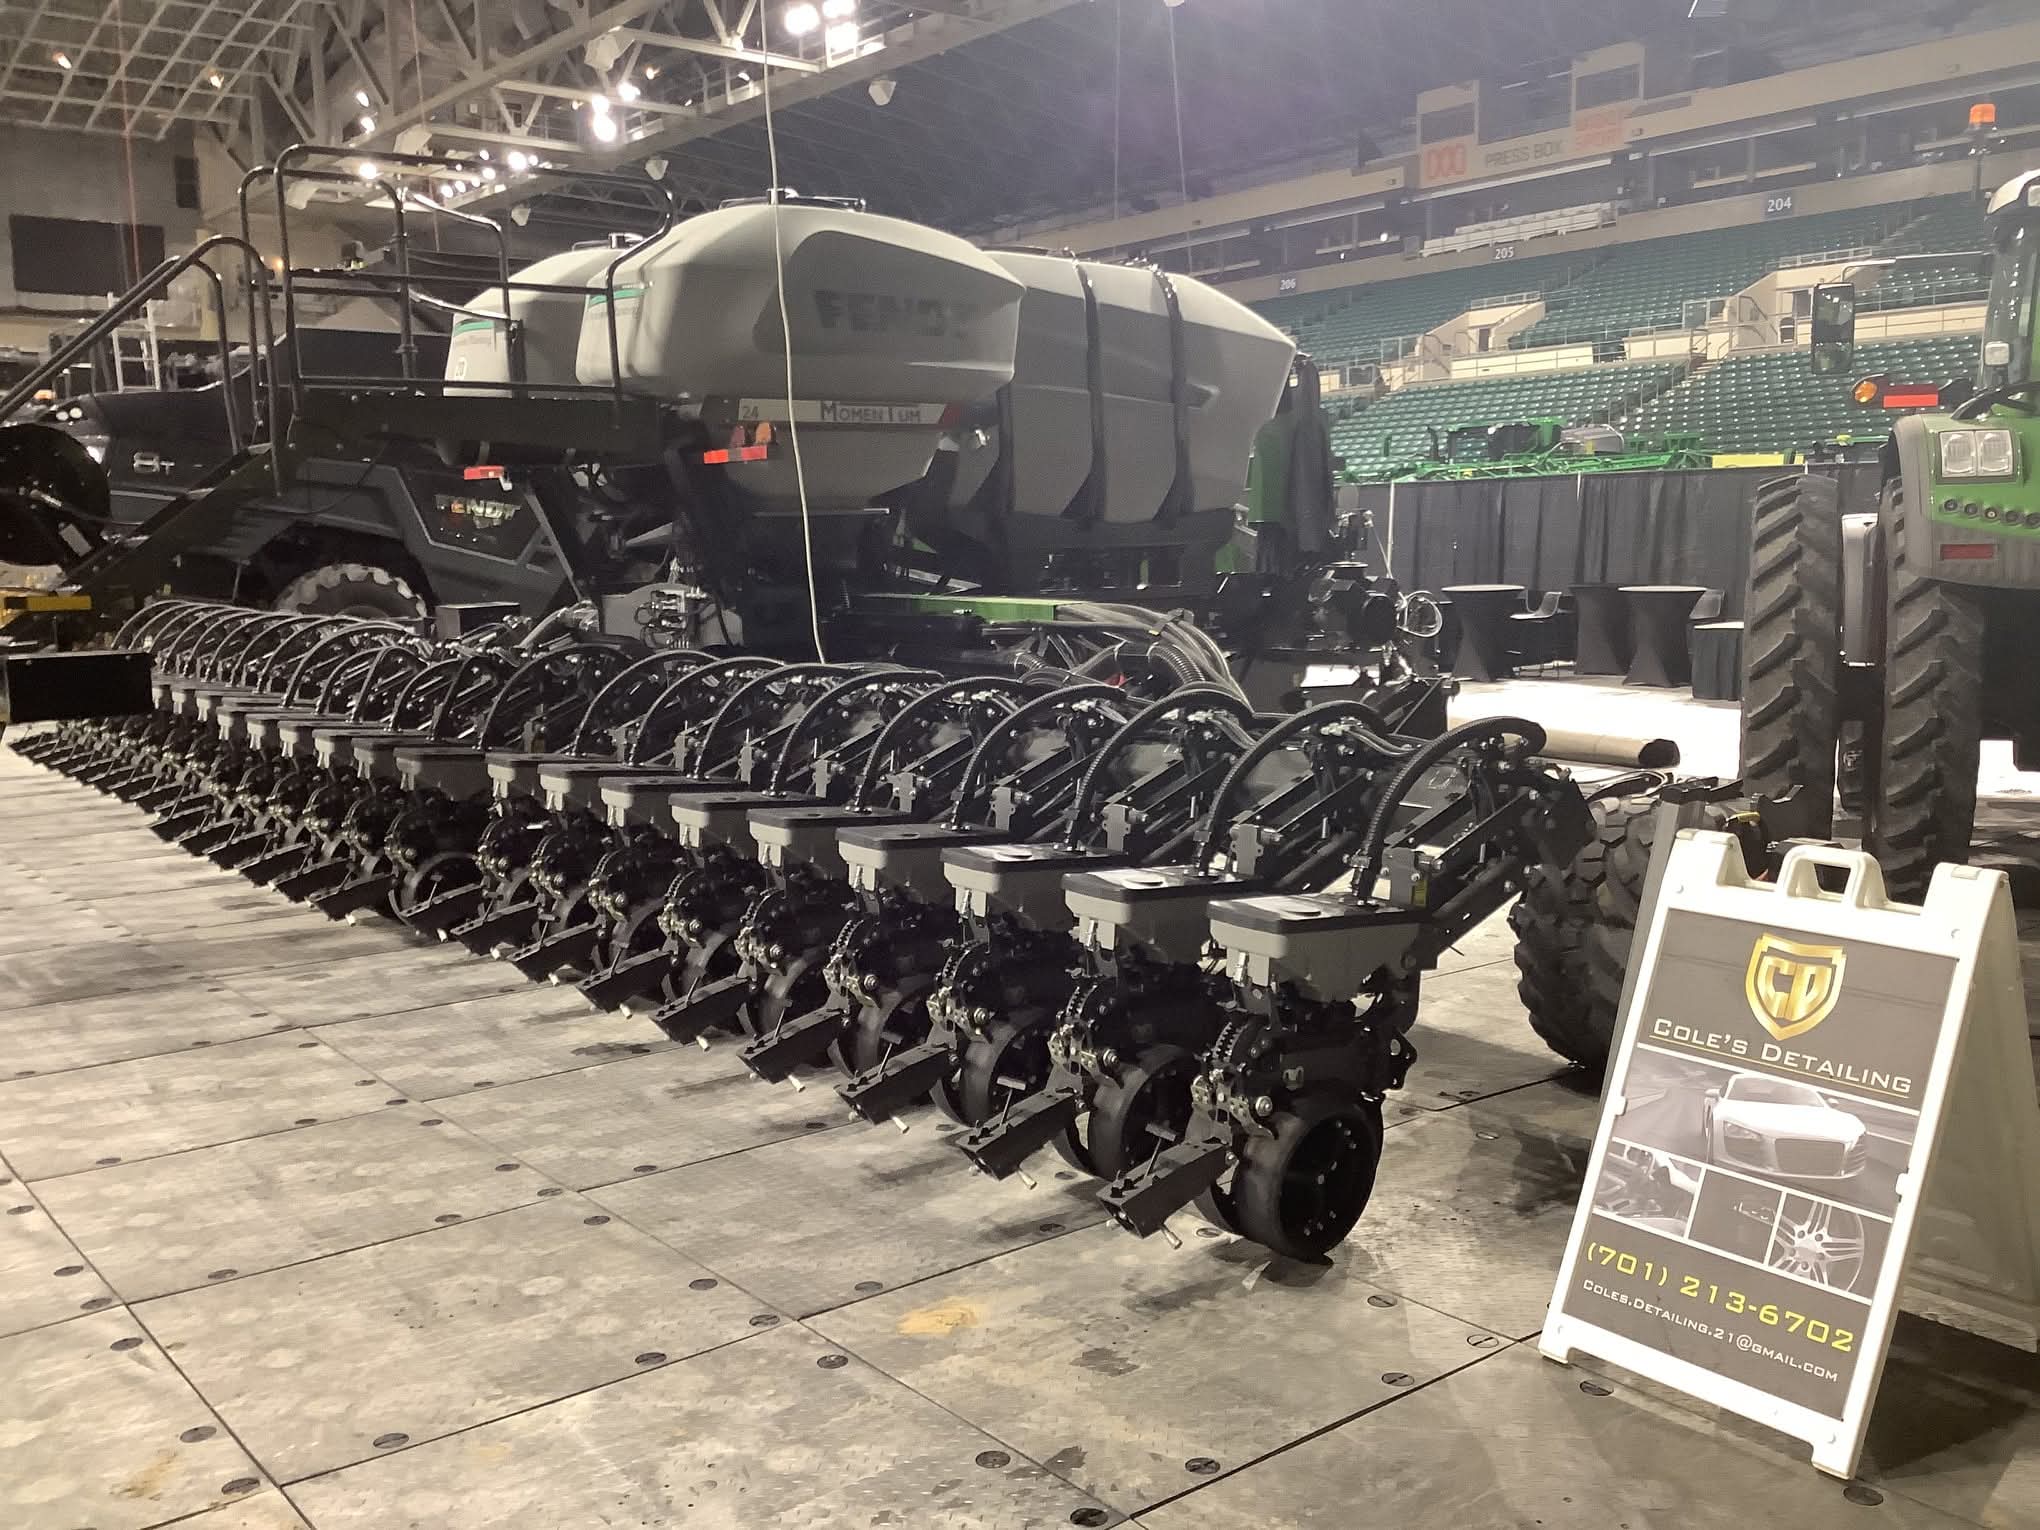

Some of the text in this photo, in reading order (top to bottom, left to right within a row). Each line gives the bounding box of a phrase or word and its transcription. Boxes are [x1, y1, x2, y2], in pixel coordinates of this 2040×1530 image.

[1484, 145, 1530, 168] PRESS
[1533, 140, 1563, 158] BOX
[1767, 196, 1792, 212] 204
[1493, 246, 1514, 260] 205
[1279, 278, 1296, 291] 206
[742, 405, 760, 420] 24
[1653, 1017, 1912, 1094] COLE'S DETAILING
[1586, 1241, 1855, 1353] (701) 213-6702
